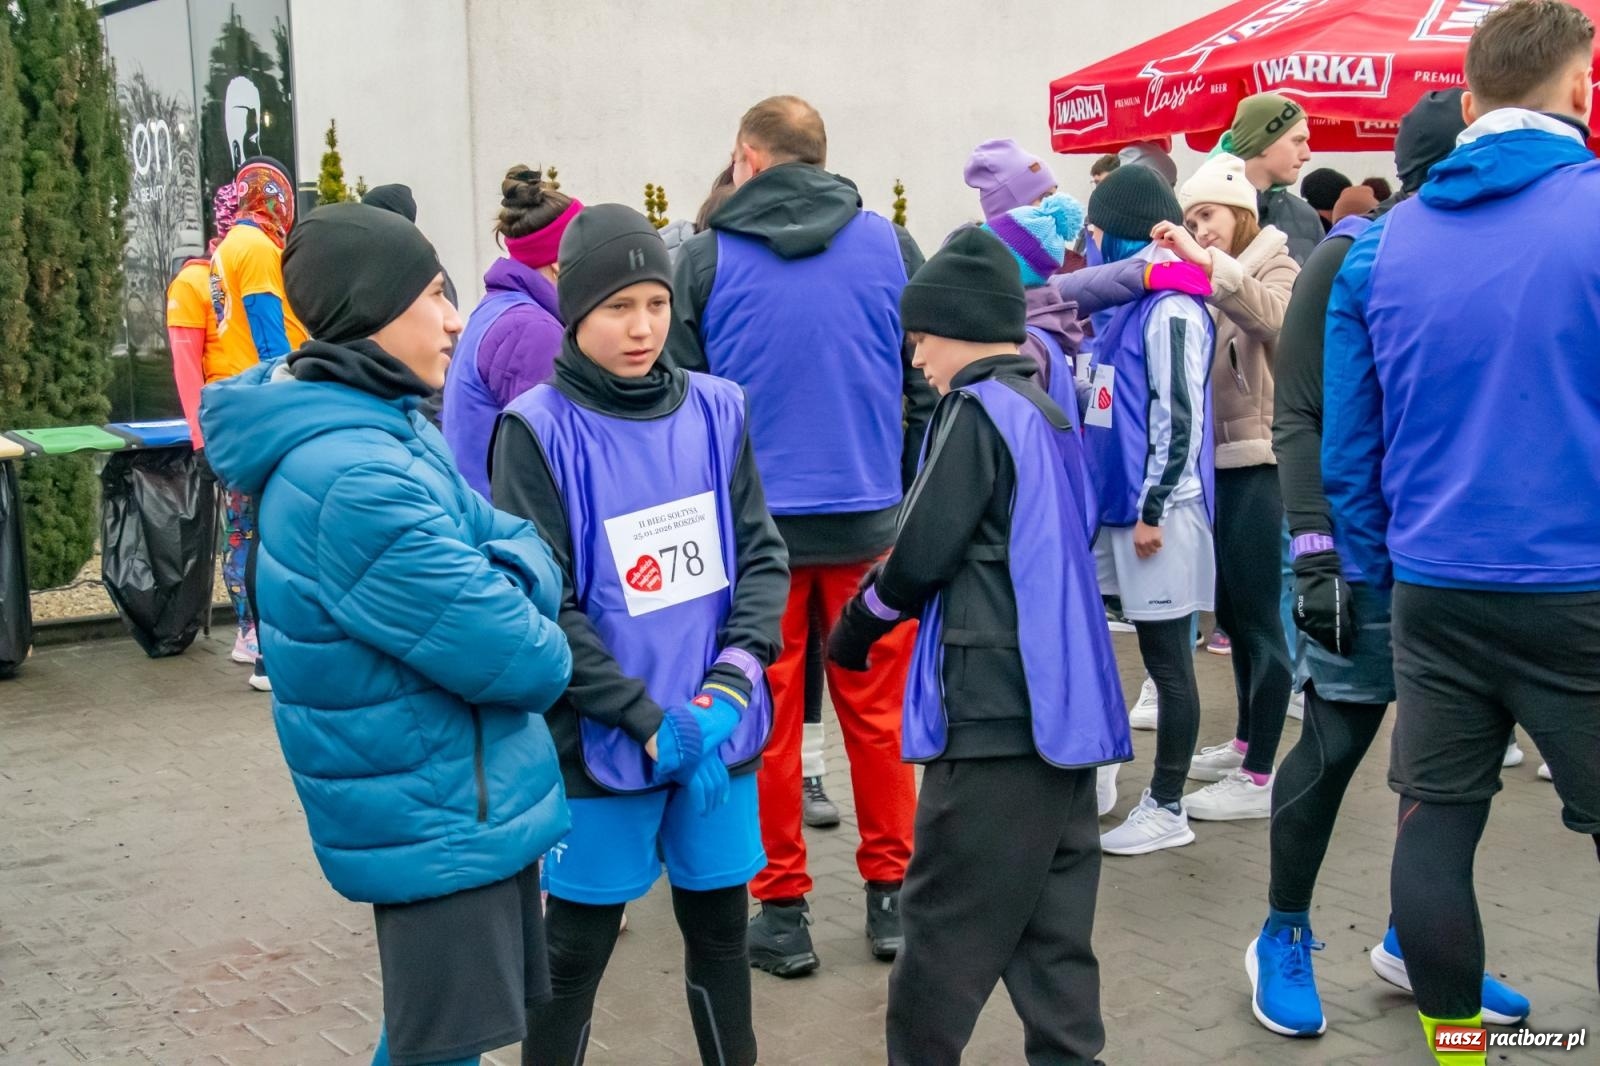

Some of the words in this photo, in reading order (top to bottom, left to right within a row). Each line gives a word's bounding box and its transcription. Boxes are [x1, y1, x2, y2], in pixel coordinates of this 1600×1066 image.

[1261, 55, 1377, 86] WARKA
[1414, 70, 1466, 84] PREMIU
[1057, 94, 1104, 125] WARKA
[1114, 96, 1141, 109] PREMIUM
[1144, 75, 1205, 117] Classic
[1210, 83, 1228, 94] BEER
[633, 524, 673, 541] 25.01.2026
[673, 514, 706, 529] ROSZKÓW
[638, 520, 647, 529] II
[647, 514, 667, 527] BIEG
[658, 540, 704, 583] 78
